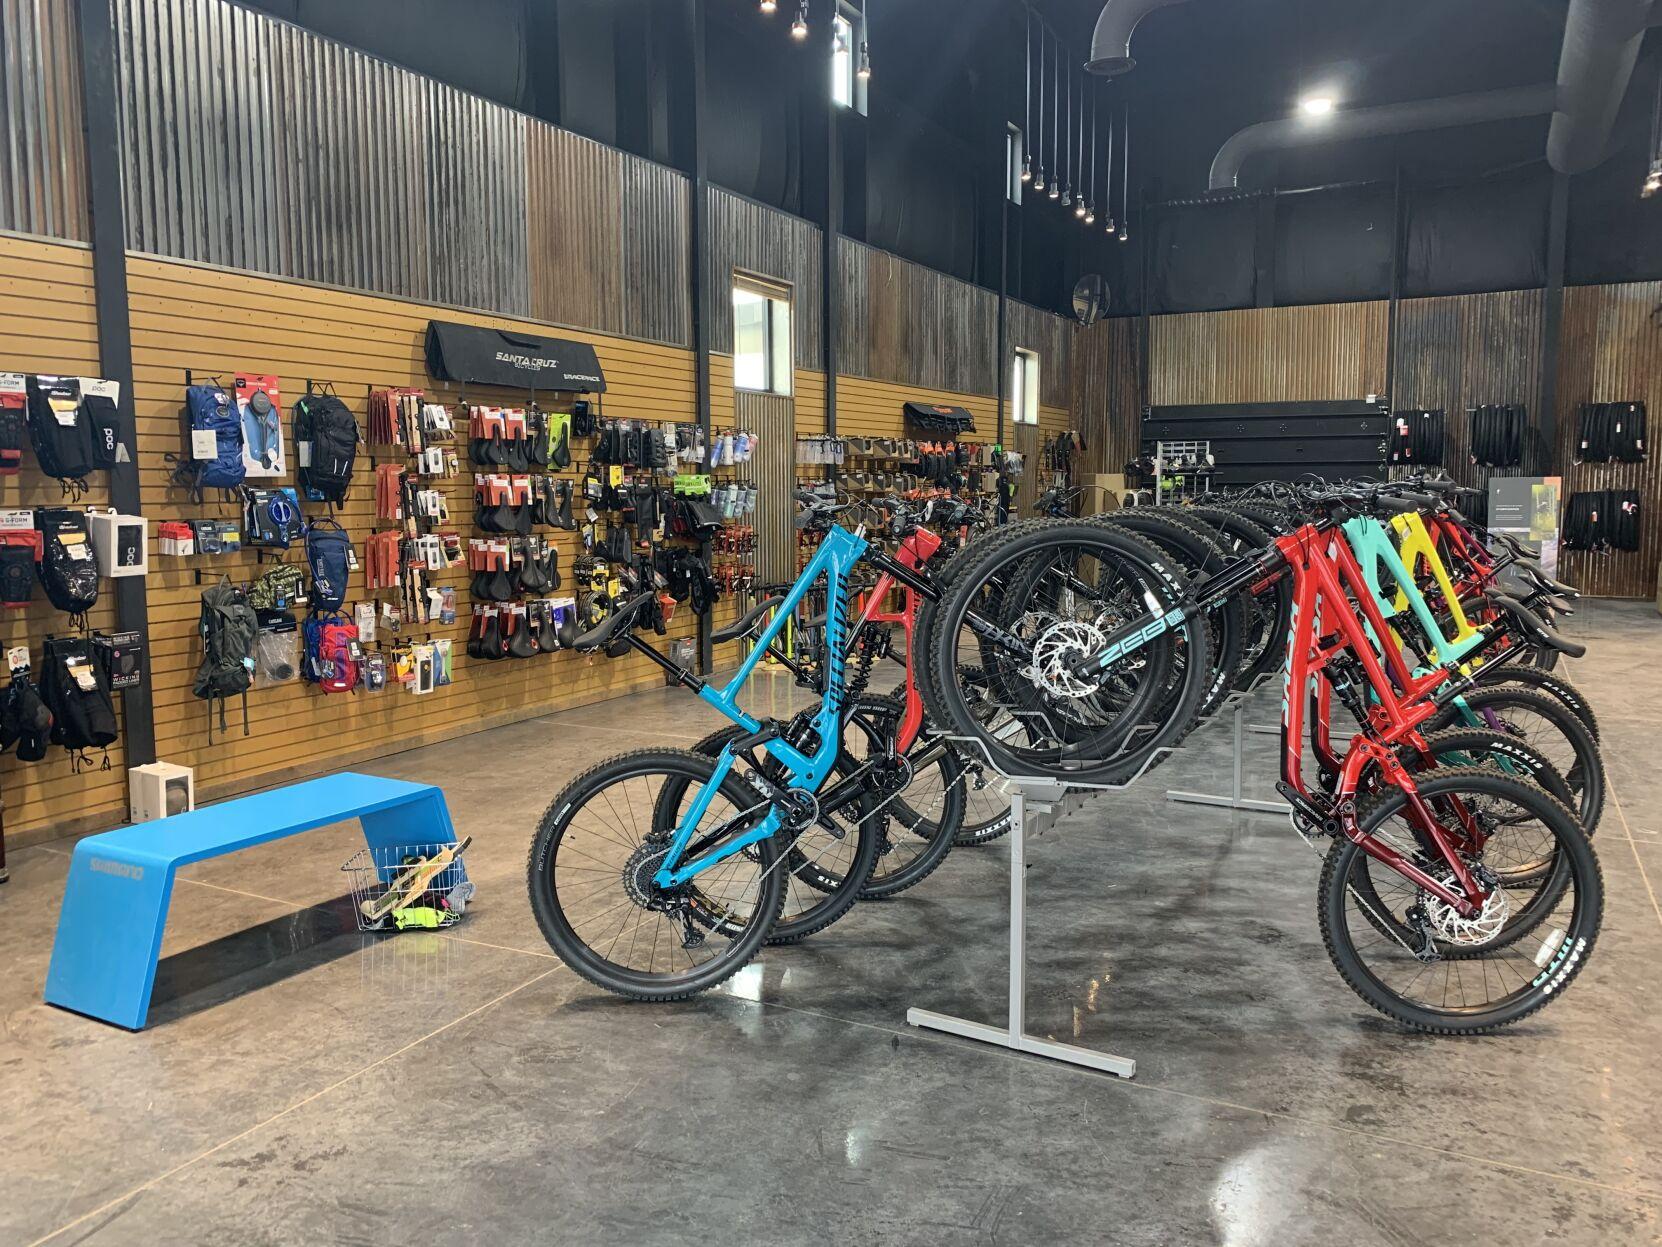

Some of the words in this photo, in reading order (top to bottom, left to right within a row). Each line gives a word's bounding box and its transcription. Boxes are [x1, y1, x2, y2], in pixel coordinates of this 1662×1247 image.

[495, 351, 530, 366] SANTA
[531, 357, 557, 368] CRUZ
[1150, 562, 1185, 599] MAXX
[1098, 618, 1167, 668] ZEB
[1201, 672, 1226, 710] MAX
[1542, 681, 1581, 709] MAXXIS
[1490, 742, 1544, 769] MAXXIS
[537, 825, 556, 872] BUTCHER
[1543, 936, 1587, 994] MAXXIS
